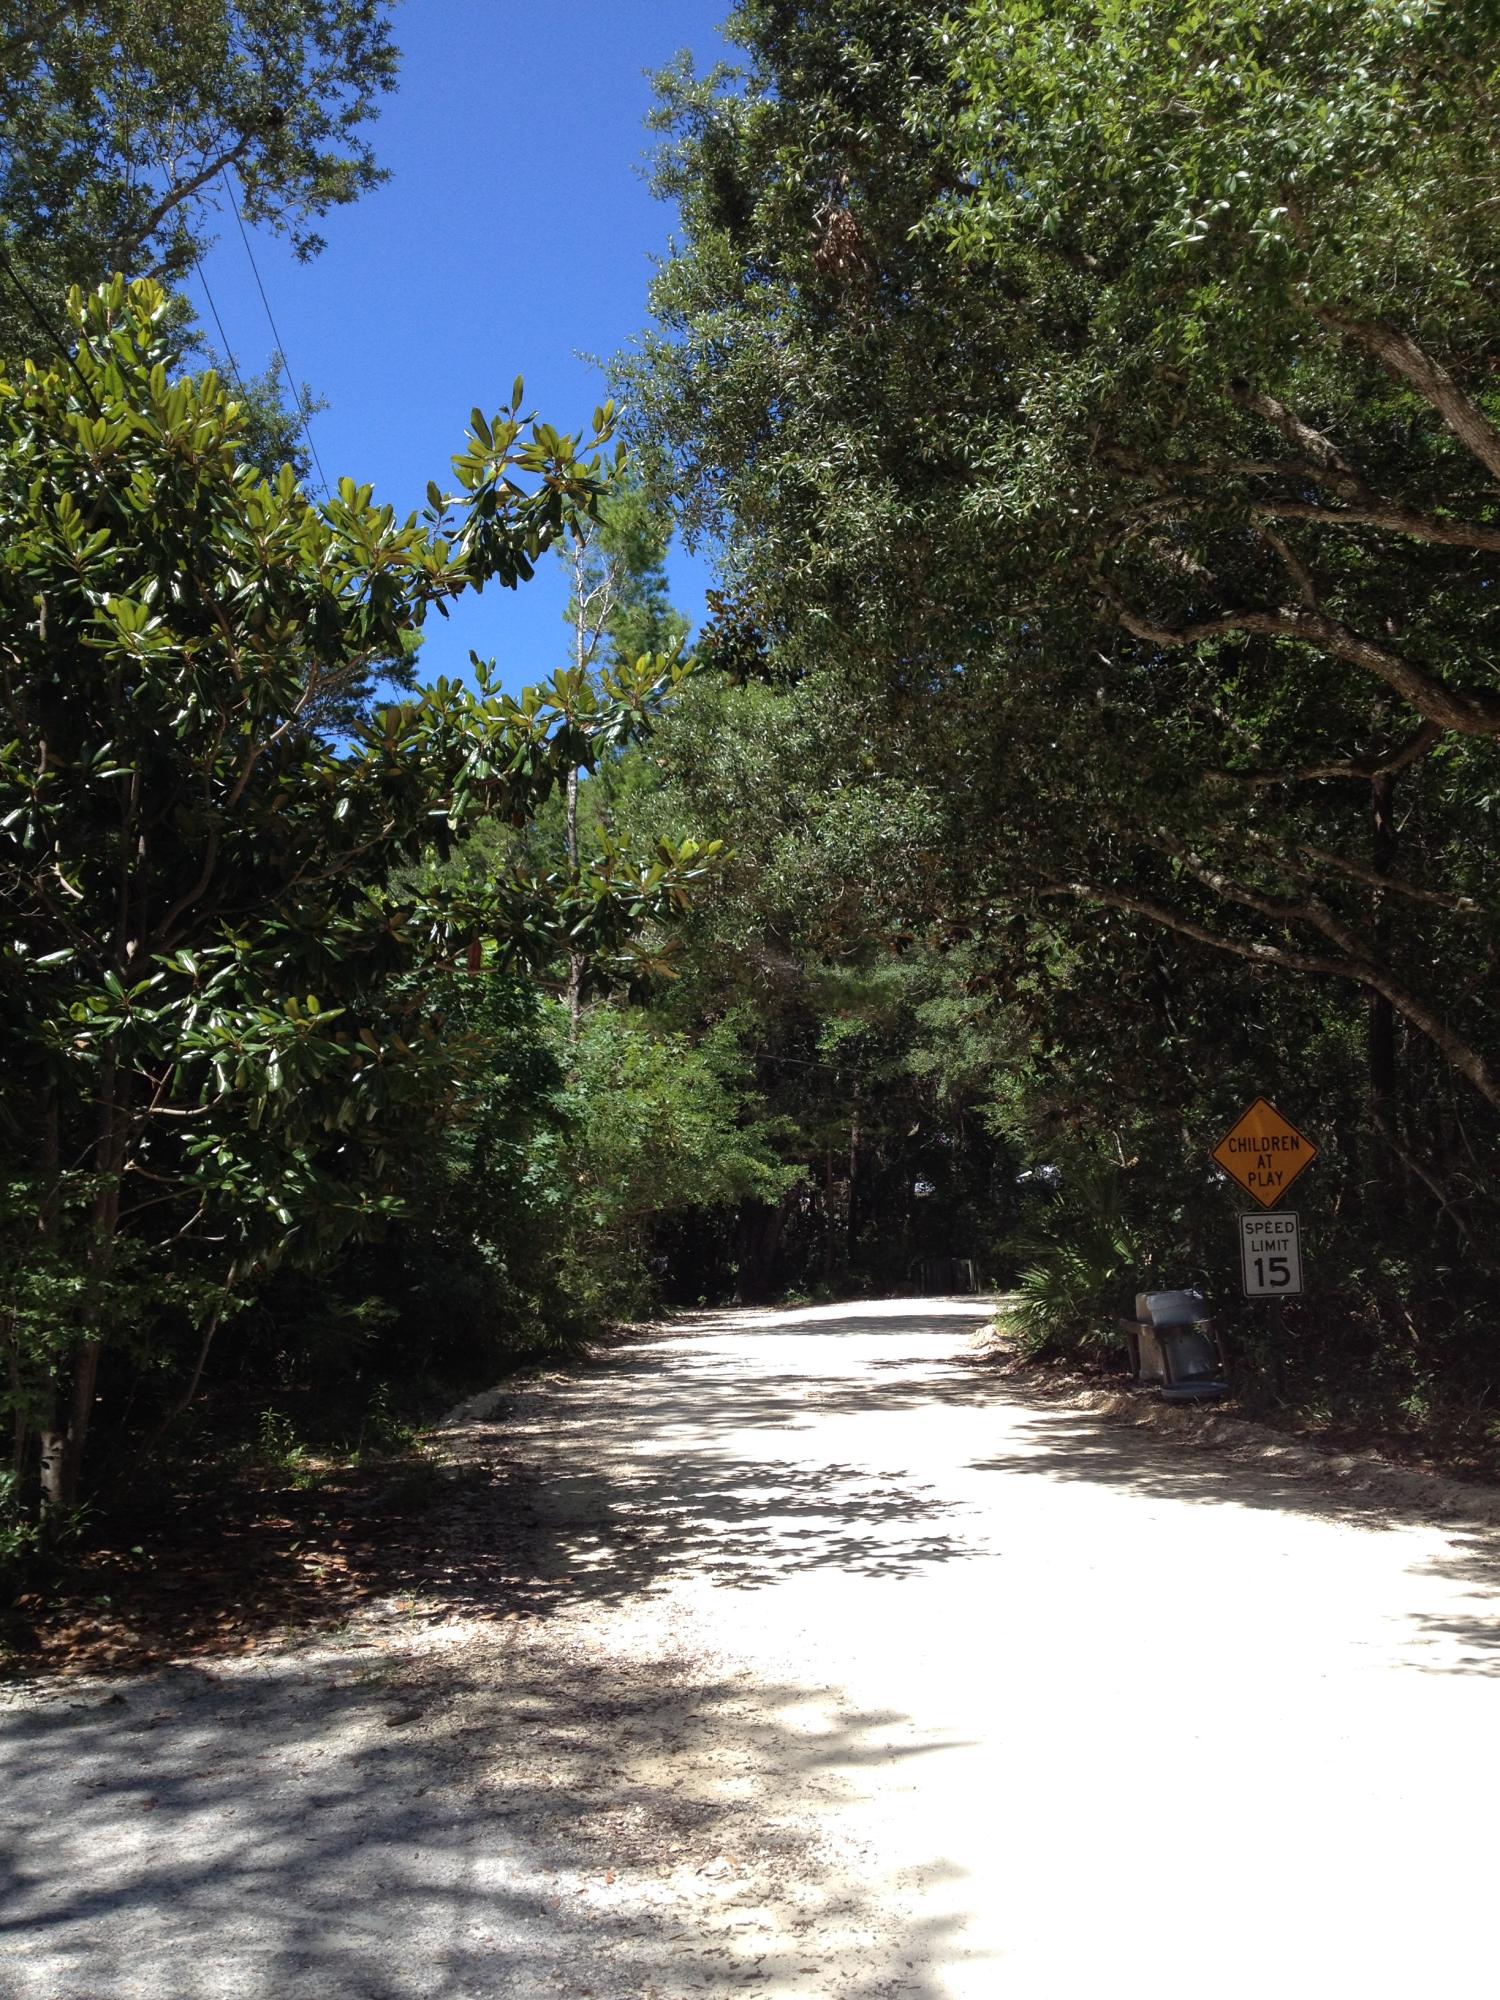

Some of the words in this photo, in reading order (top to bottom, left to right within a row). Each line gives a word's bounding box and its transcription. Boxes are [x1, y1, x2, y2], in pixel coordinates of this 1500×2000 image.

[1228, 1136, 1300, 1153] CHILDREN
[1257, 1154, 1273, 1169] AT
[1248, 1171, 1284, 1187] PLAY
[1245, 1221, 1295, 1235] SPEED
[1251, 1239, 1289, 1252] LIMIT
[1254, 1257, 1291, 1287] 15
